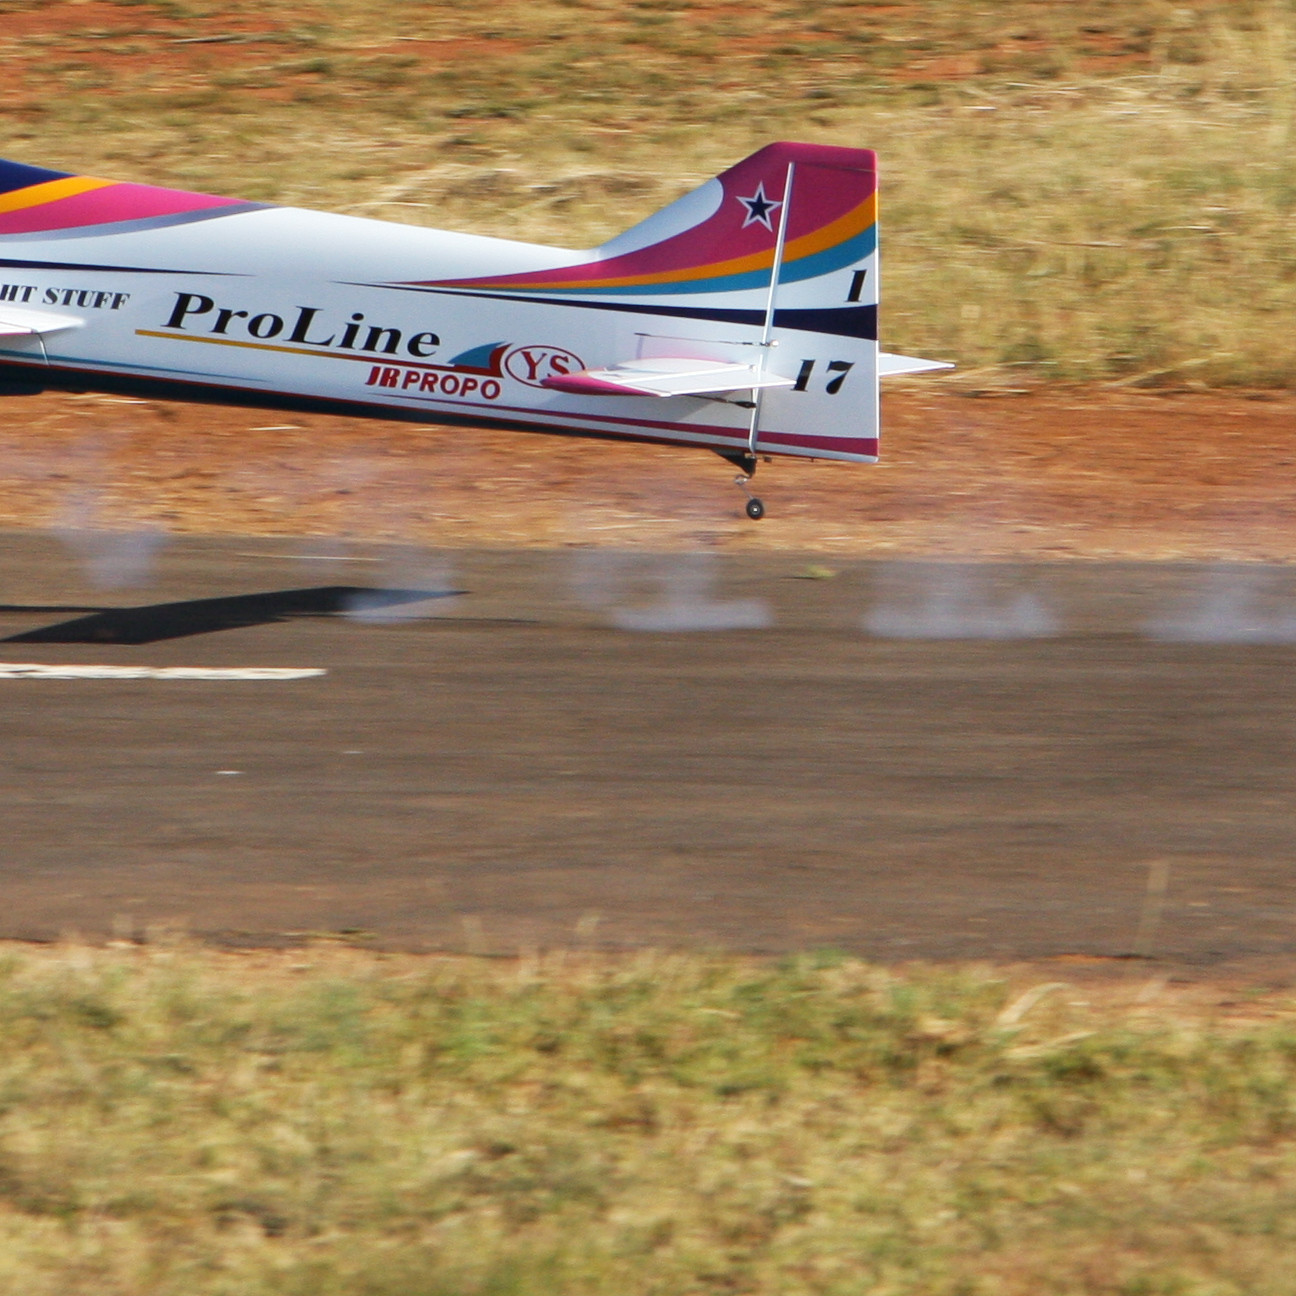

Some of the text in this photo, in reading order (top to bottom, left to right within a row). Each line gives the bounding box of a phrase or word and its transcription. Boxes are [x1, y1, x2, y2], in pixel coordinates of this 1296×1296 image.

[42, 287, 130, 310] STUFF
[160, 291, 441, 357] ProLine
[520, 351, 570, 380] YS
[790, 359, 856, 395] 17
